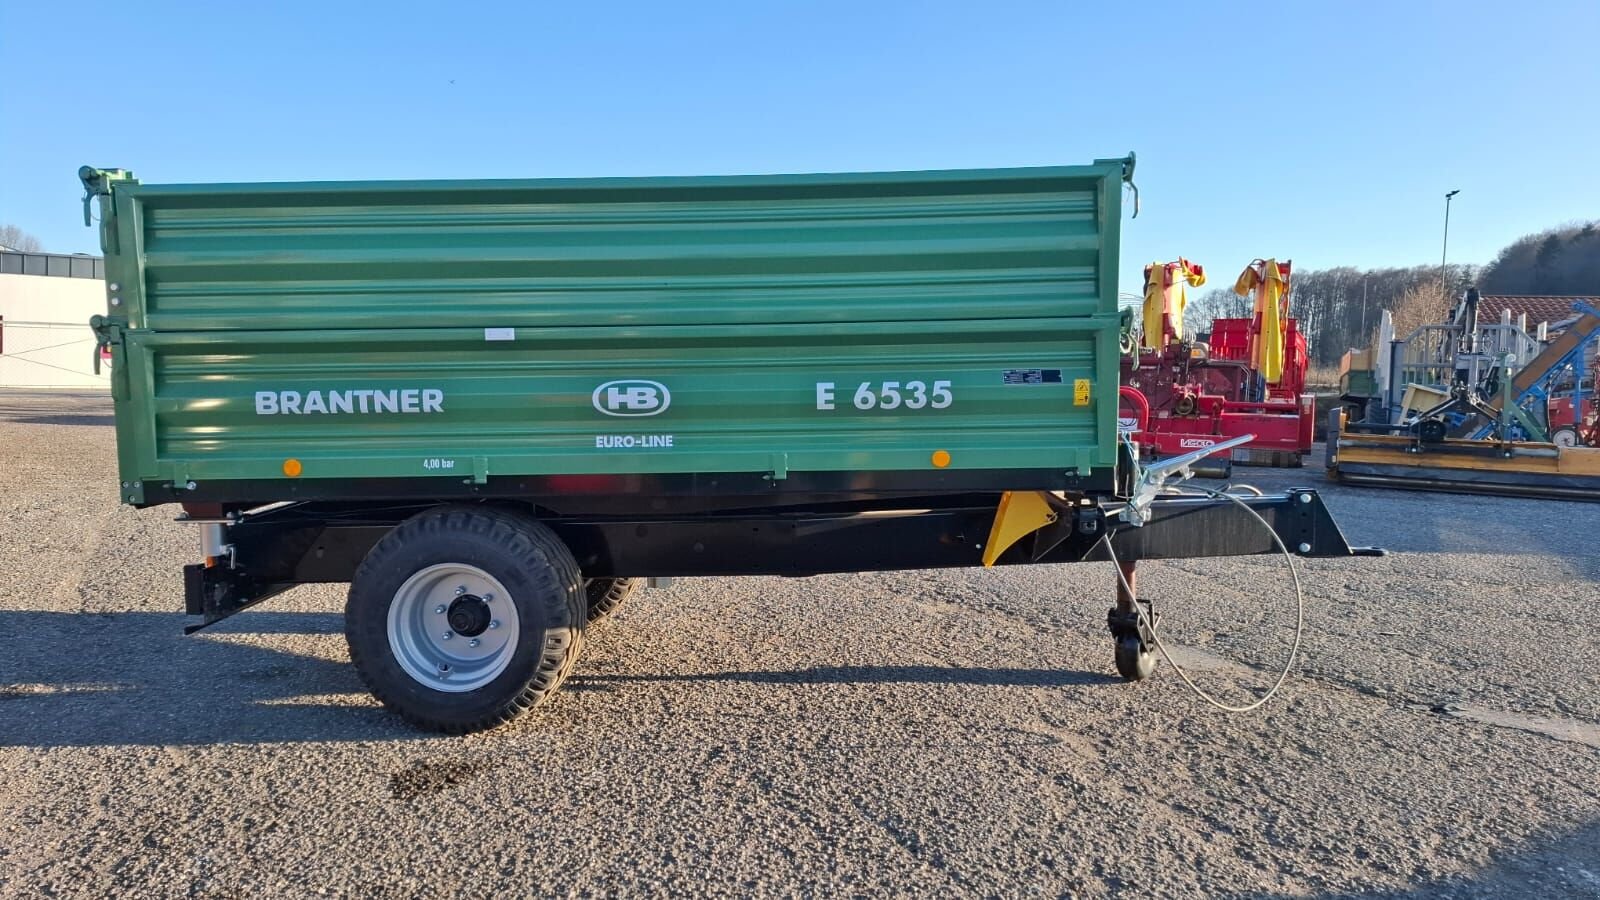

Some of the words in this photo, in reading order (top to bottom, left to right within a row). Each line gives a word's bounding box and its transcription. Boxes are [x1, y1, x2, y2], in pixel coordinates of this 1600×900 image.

[255, 388, 445, 415] BRANTNER
[607, 386, 659, 410] HB
[816, 382, 835, 410] E
[853, 380, 953, 410] 6535
[596, 435, 673, 448] EURO-LINE
[423, 458, 440, 470] 4,00
[441, 458, 454, 469] bar
